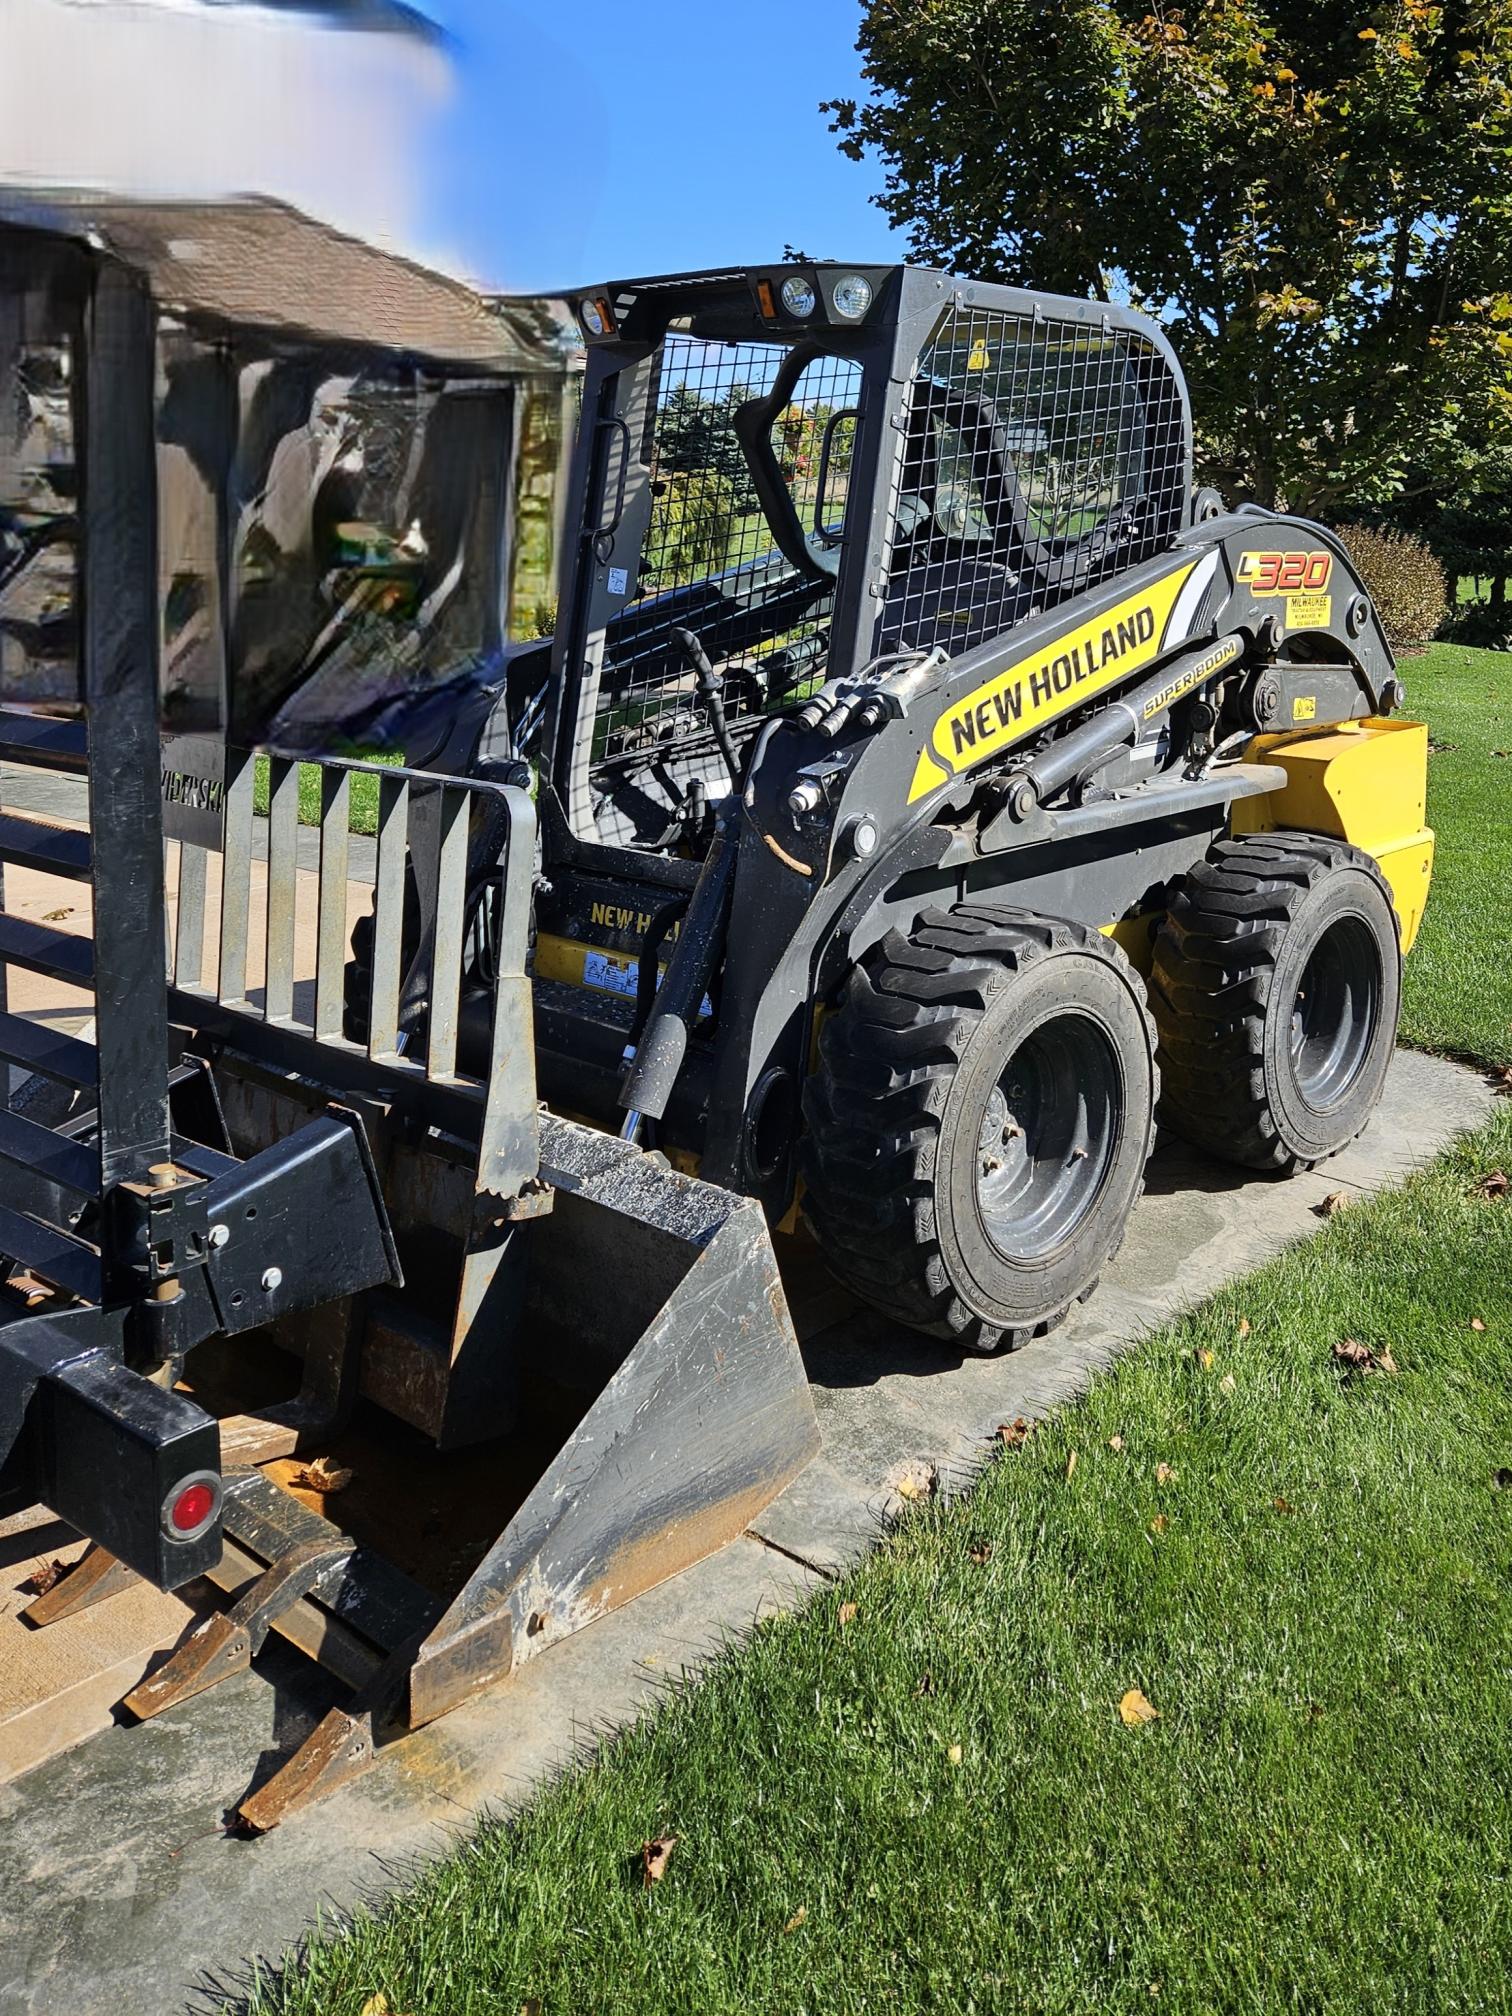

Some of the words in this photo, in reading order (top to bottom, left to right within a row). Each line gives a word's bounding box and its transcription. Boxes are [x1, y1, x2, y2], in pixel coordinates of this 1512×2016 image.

[1237, 553, 1332, 592] L320
[951, 681, 1022, 755] NEW
[1029, 605, 1155, 709] HOLLAND
[1145, 672, 1193, 716] SUPER
[1195, 642, 1235, 678] BOOM
[590, 902, 635, 930] NEW
